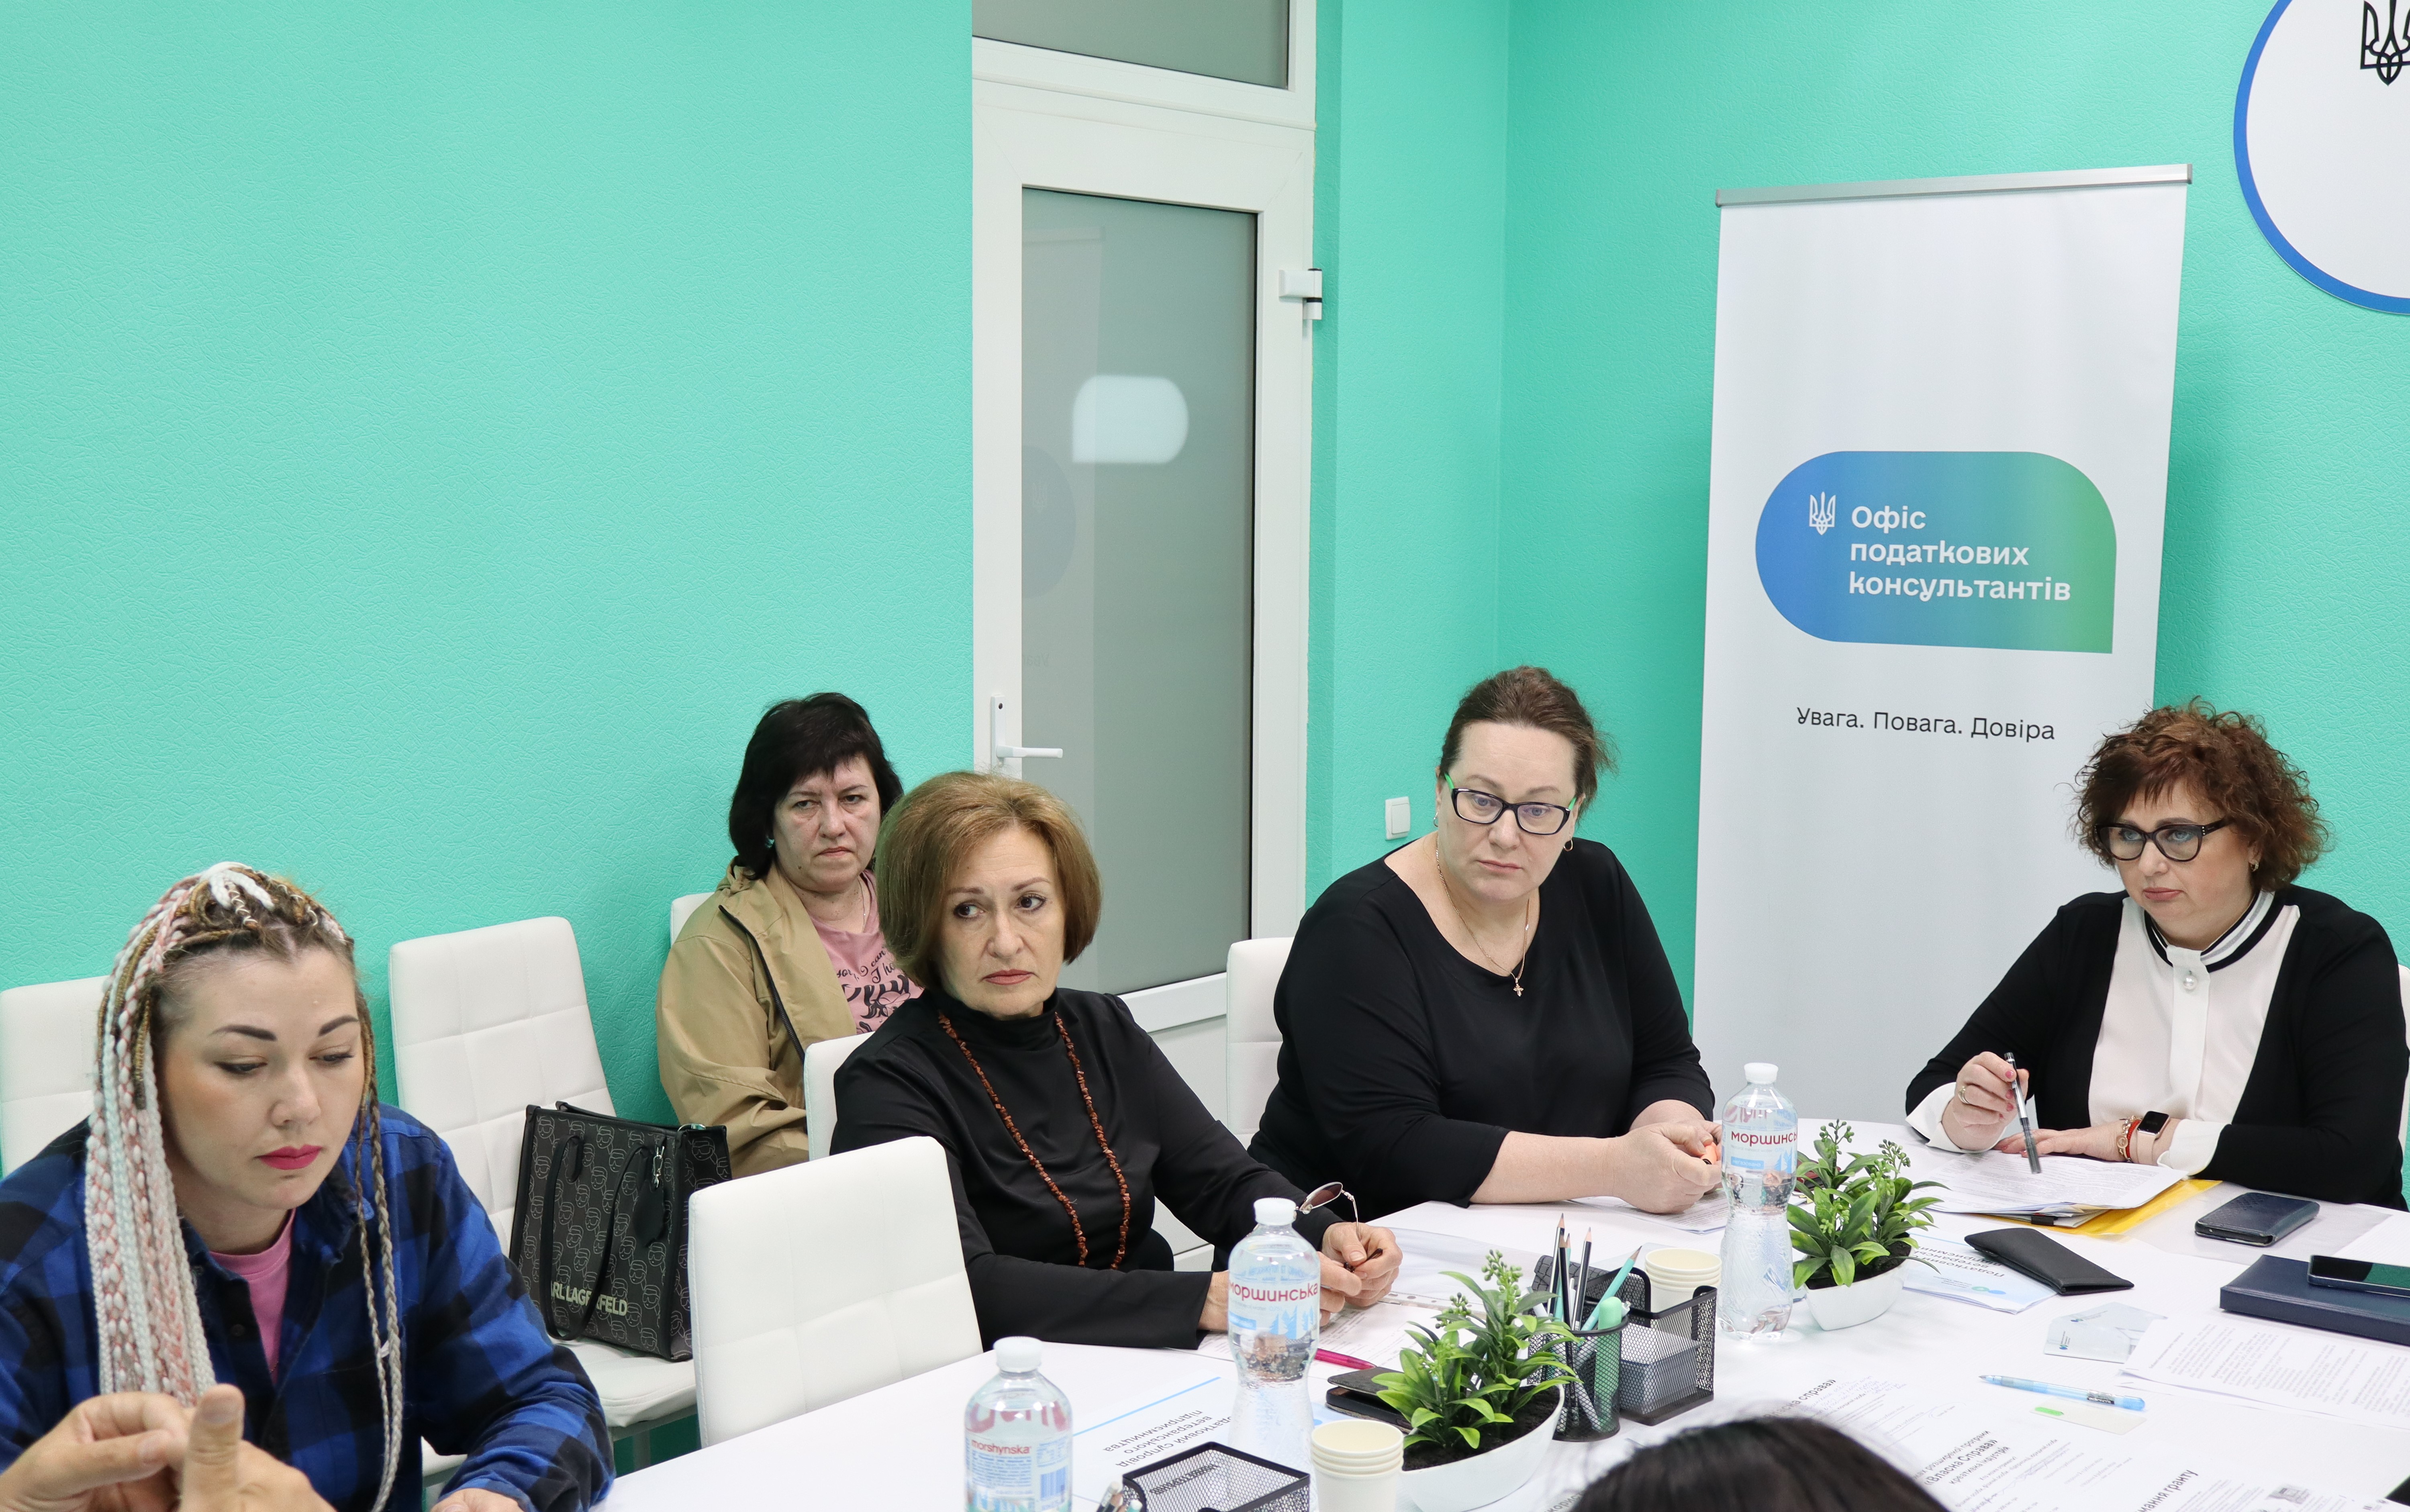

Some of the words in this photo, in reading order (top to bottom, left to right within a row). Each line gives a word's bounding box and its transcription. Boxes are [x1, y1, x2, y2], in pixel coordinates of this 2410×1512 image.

[1851, 506, 1926, 533] Офіс
[1850, 541, 2029, 566] податкових
[1849, 572, 2071, 602] консультантів
[1796, 707, 1864, 728] Увага.
[1873, 712, 1963, 734] Повага.
[1971, 718, 2055, 743] Довіра
[1731, 1130, 1797, 1147] моршинсь
[566, 1285, 627, 1316] LAGEFELD
[1103, 1410, 1203, 1453] підприємництва
[1123, 1416, 1213, 1455] ветеранського
[972, 1439, 1031, 1455] morshynska
[1114, 1442, 1173, 1468] супровід
[1957, 1439, 1998, 1461] Справа»
[2163, 1470, 2199, 1493] гранту
